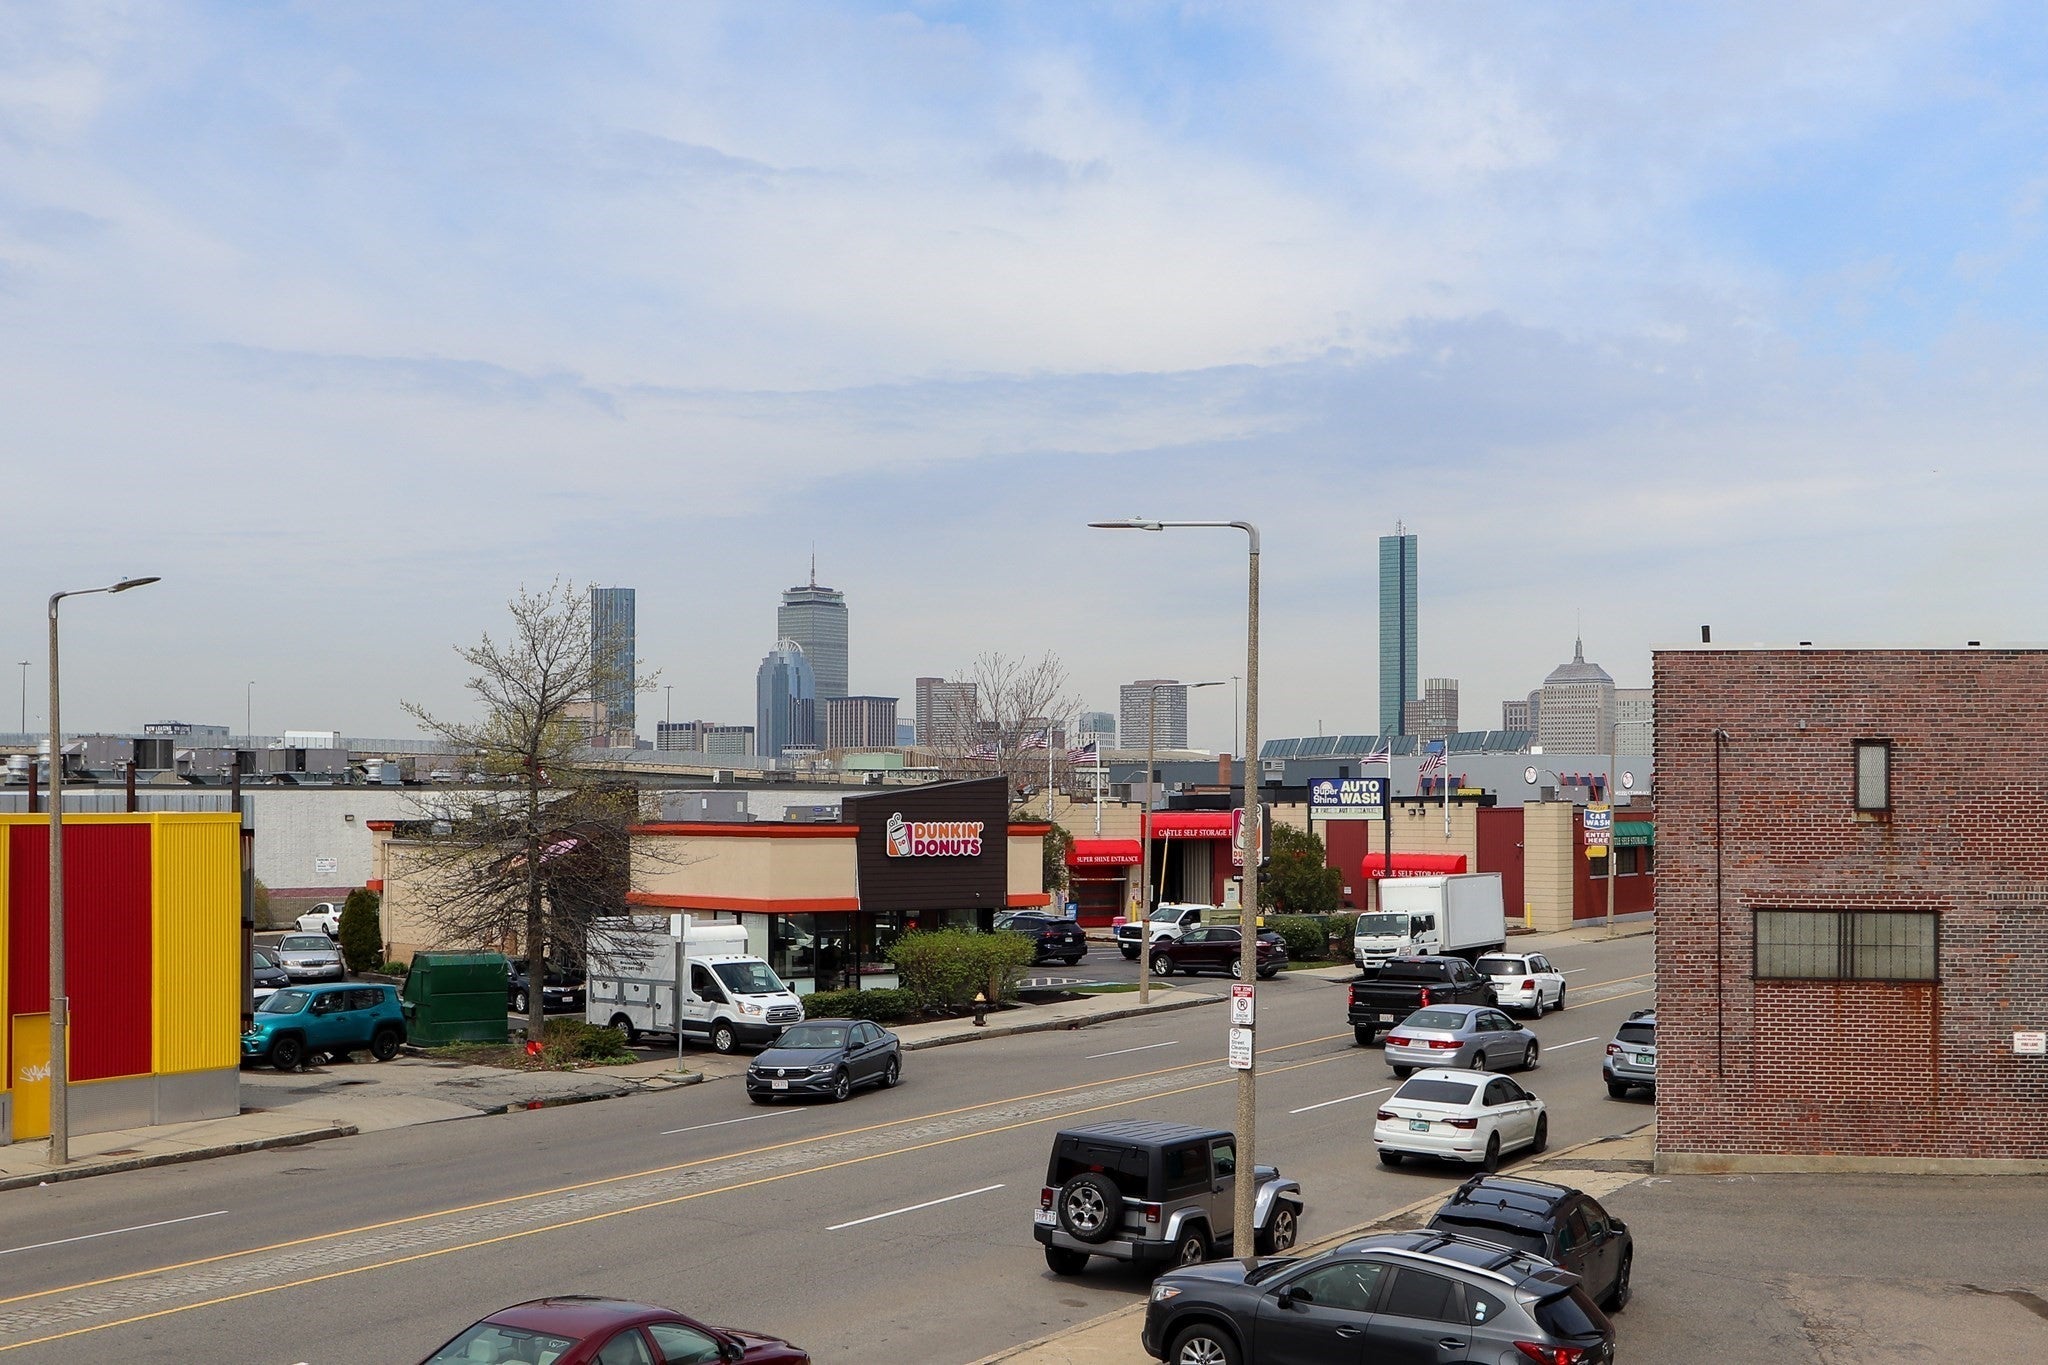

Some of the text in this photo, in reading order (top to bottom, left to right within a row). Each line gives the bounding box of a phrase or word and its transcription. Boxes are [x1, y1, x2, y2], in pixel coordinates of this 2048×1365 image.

[1313, 785, 1339, 796] Super
[1341, 780, 1380, 792] AUTO
[1313, 794, 1338, 804] Shine
[1340, 792, 1381, 804] WASH
[914, 823, 982, 838] DUNKIN'
[1158, 829, 1182, 837] CASTLE
[1183, 829, 1198, 837] SELF
[1199, 829, 1227, 837] STORAGE
[914, 840, 980, 855] DONUTS
[1398, 870, 1413, 878] SELF
